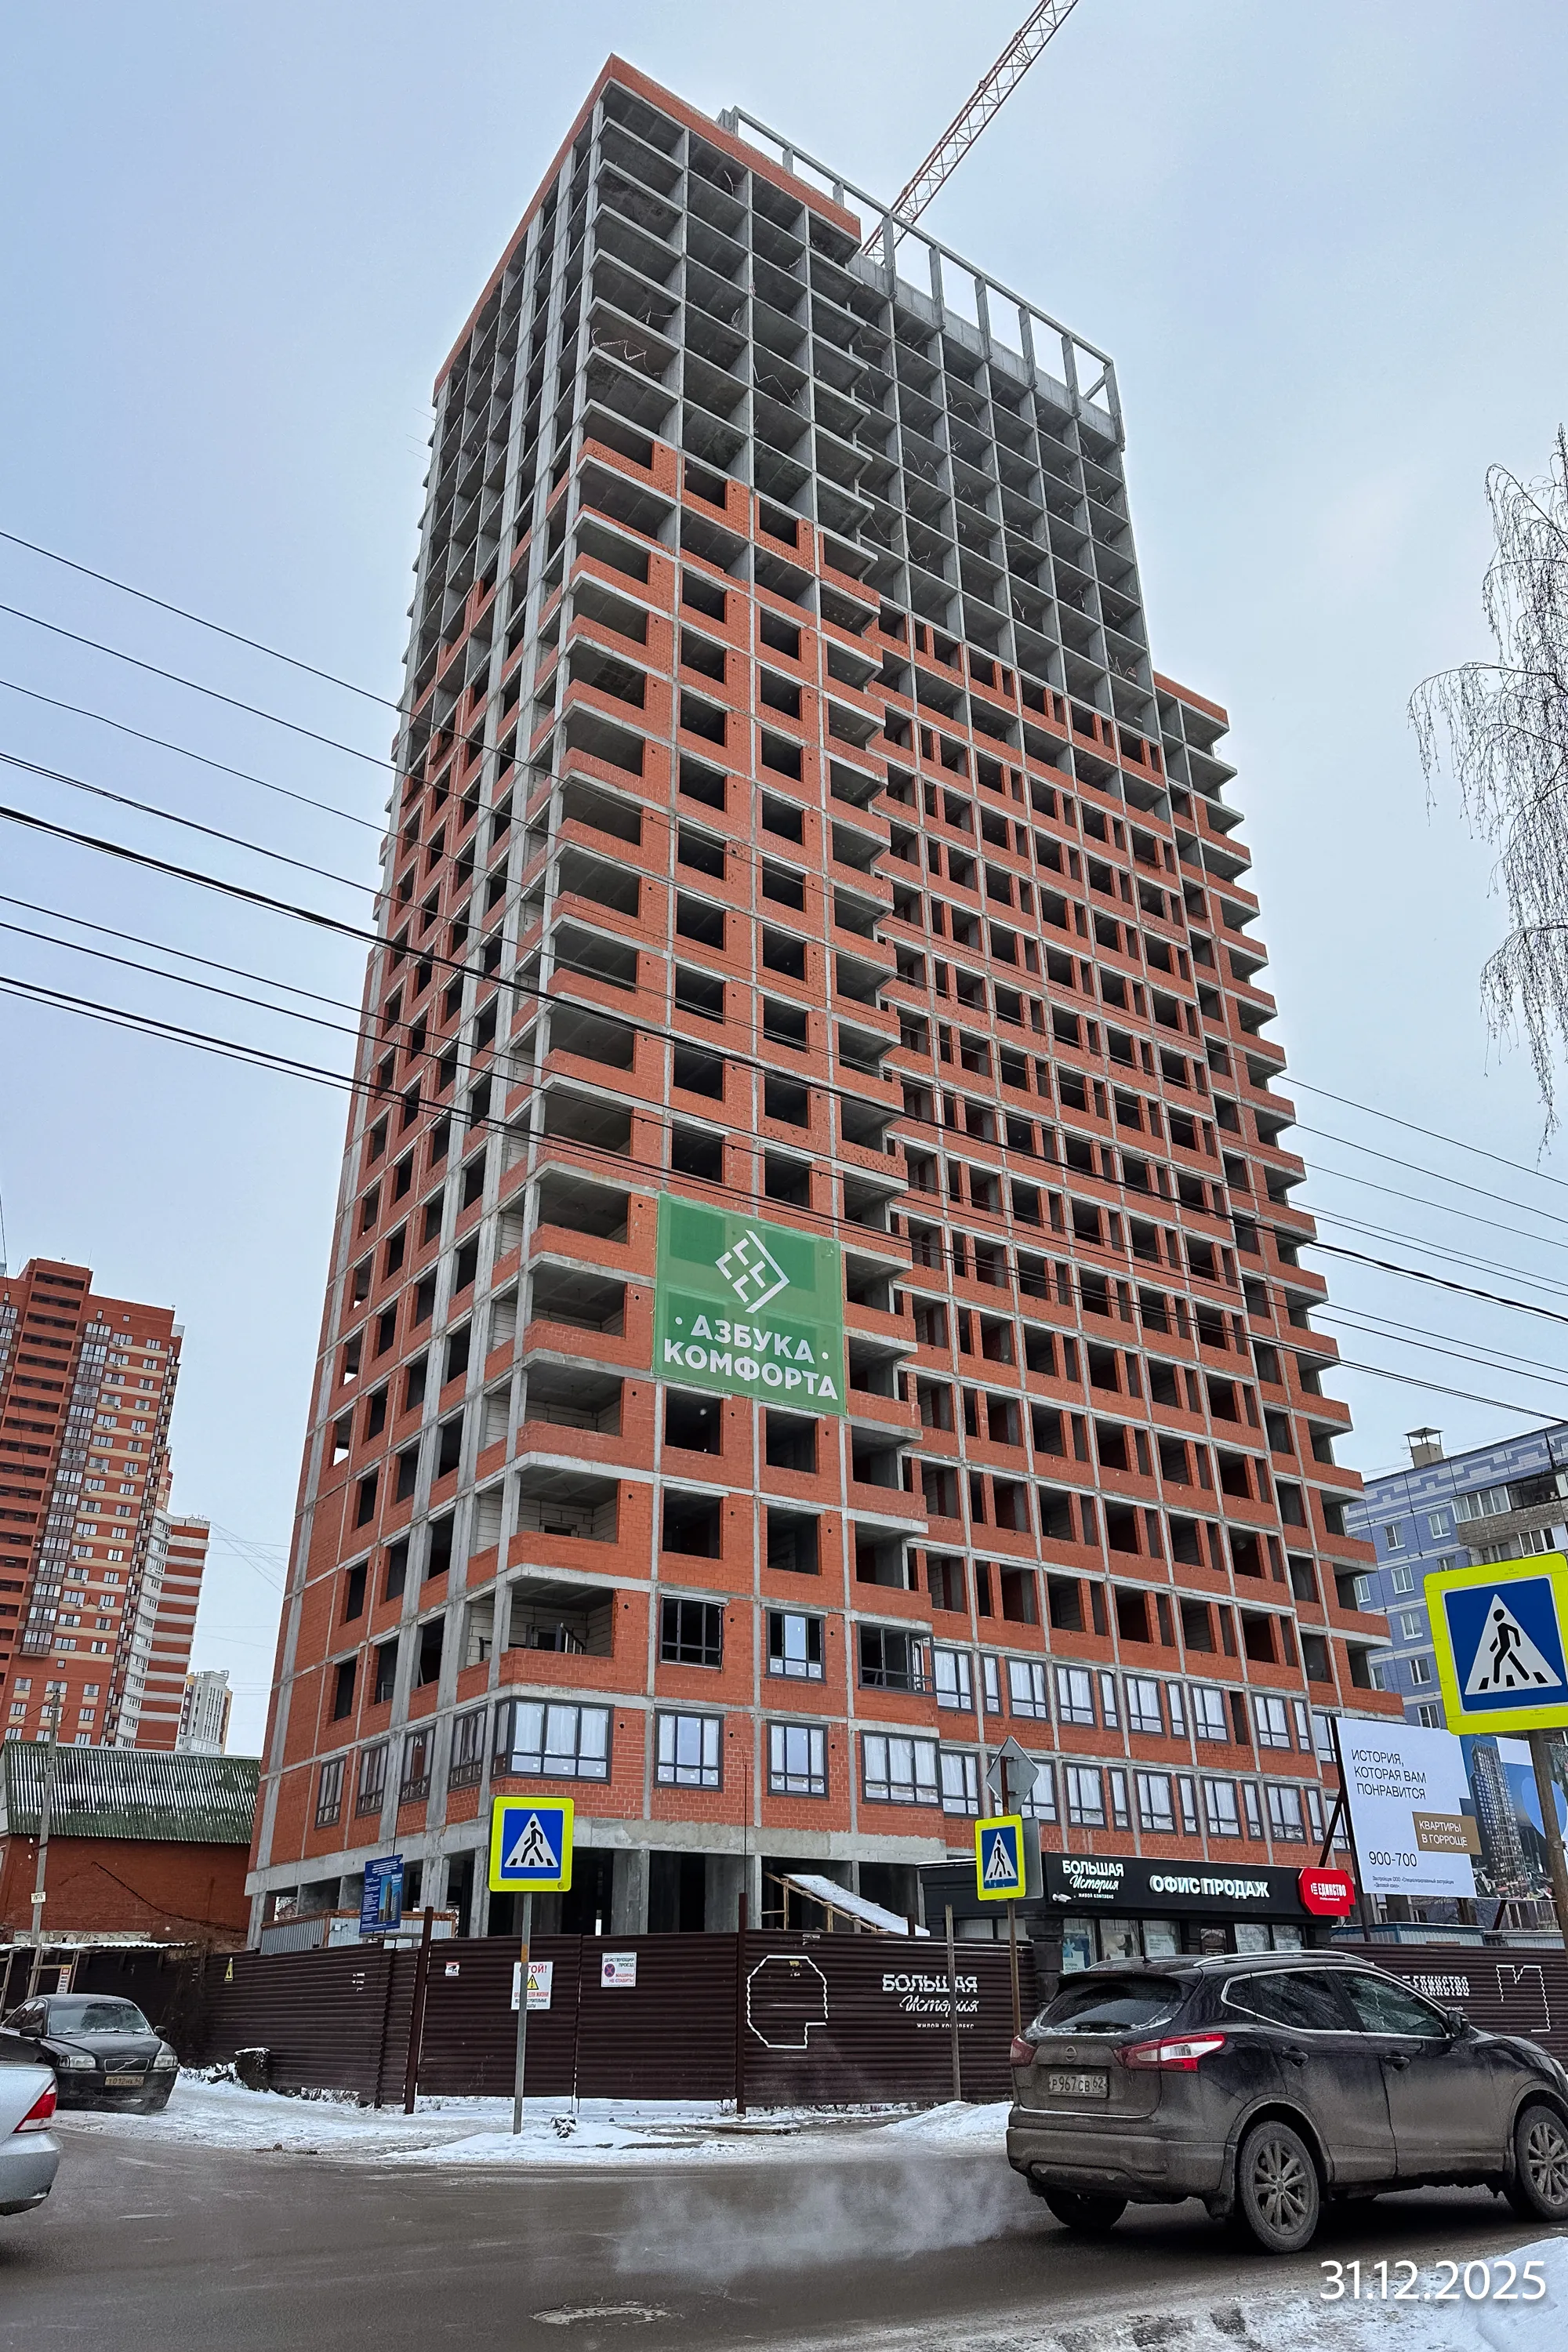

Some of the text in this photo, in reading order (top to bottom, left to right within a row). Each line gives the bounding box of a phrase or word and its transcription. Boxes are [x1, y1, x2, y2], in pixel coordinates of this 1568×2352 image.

[690, 1314, 815, 1364] АЗБУКА
[664, 1338, 839, 1400] КОМФОРТА
[1351, 1749, 1404, 1767] ИСТОРИЯ,
[1354, 1766, 1427, 1784] КОТОРАЯ ВАМ
[1356, 1783, 1426, 1800] ПОНРАВИТСЯ
[1418, 1820, 1462, 1833] КВАРТИРЫ
[1421, 1834, 1468, 1847] В ГОРРОЩЕ
[1368, 1851, 1417, 1867] 900-700
[1062, 1860, 1124, 1877] БОЛЬШАЯ
[1069, 1875, 1120, 1893] История
[1150, 1875, 1270, 1900] ОФИС ПРОДАЖ
[1318, 1882, 1347, 1897] ЕДИНСТВО
[1051, 2076, 1104, 2092] Р967СВ 62
